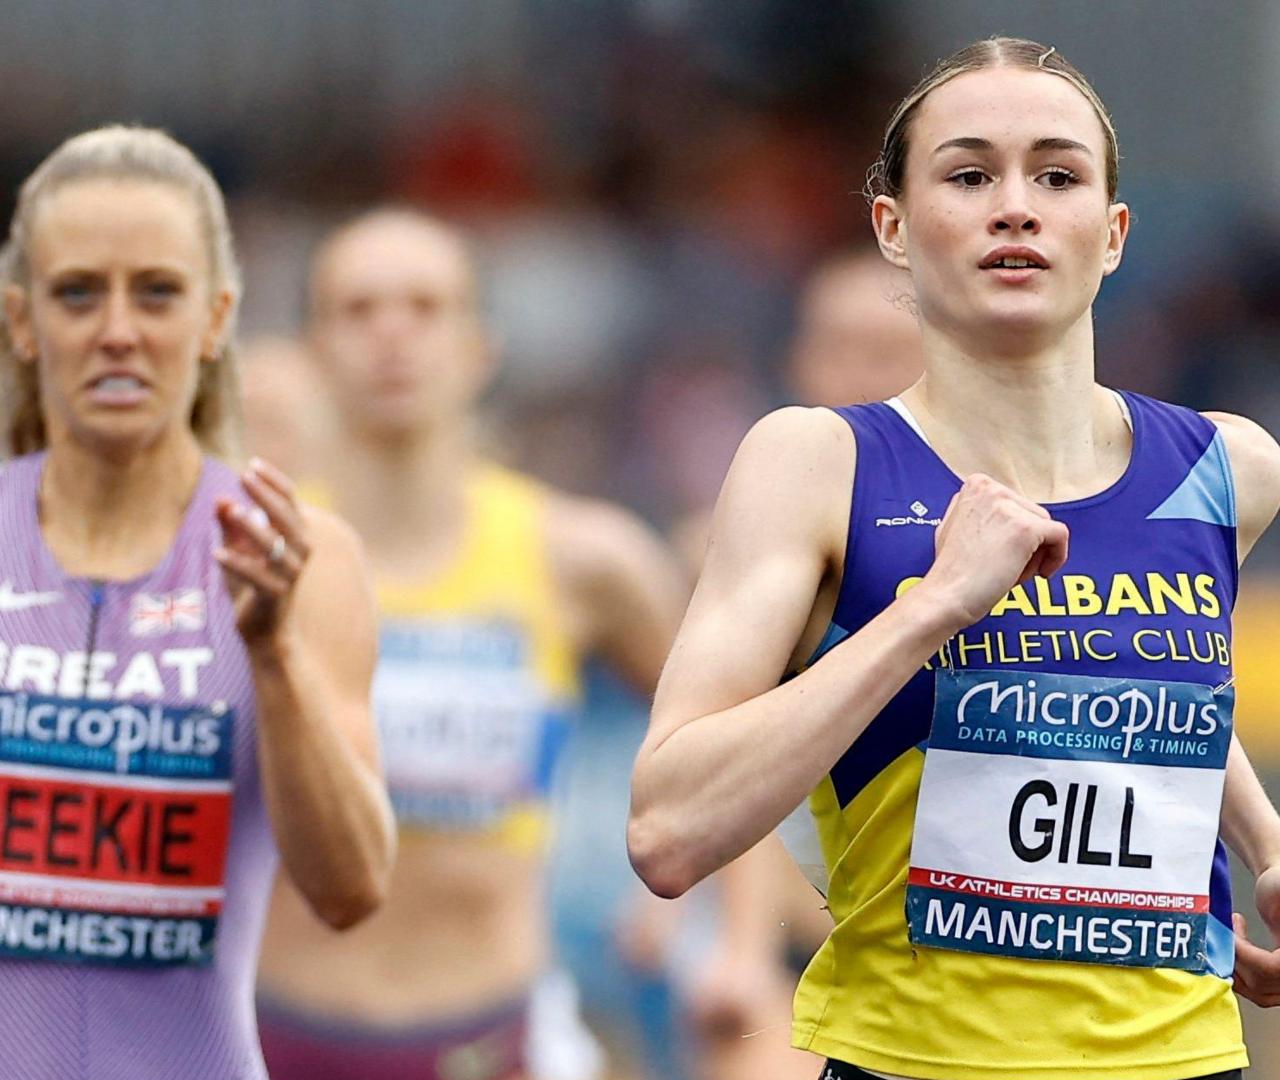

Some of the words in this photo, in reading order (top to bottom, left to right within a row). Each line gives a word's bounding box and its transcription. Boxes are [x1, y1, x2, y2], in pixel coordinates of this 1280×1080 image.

[989, 572, 1222, 620] ALBANS
[923, 629, 1118, 671] THLETIC
[1133, 629, 1232, 666] CLUB
[956, 679, 1218, 758] Microplus
[958, 726, 1008, 744] DATA
[1016, 731, 1122, 751] PROCESSING
[1132, 738, 1144, 752] &
[1149, 739, 1209, 756] TIMING
[1008, 779, 1153, 870] GILL
[929, 873, 957, 888] UK
[959, 879, 1061, 901] ATHLETICS
[1065, 889, 1195, 909] CHAMPIONSHIPS
[924, 899, 1192, 959] MANCHESTER
